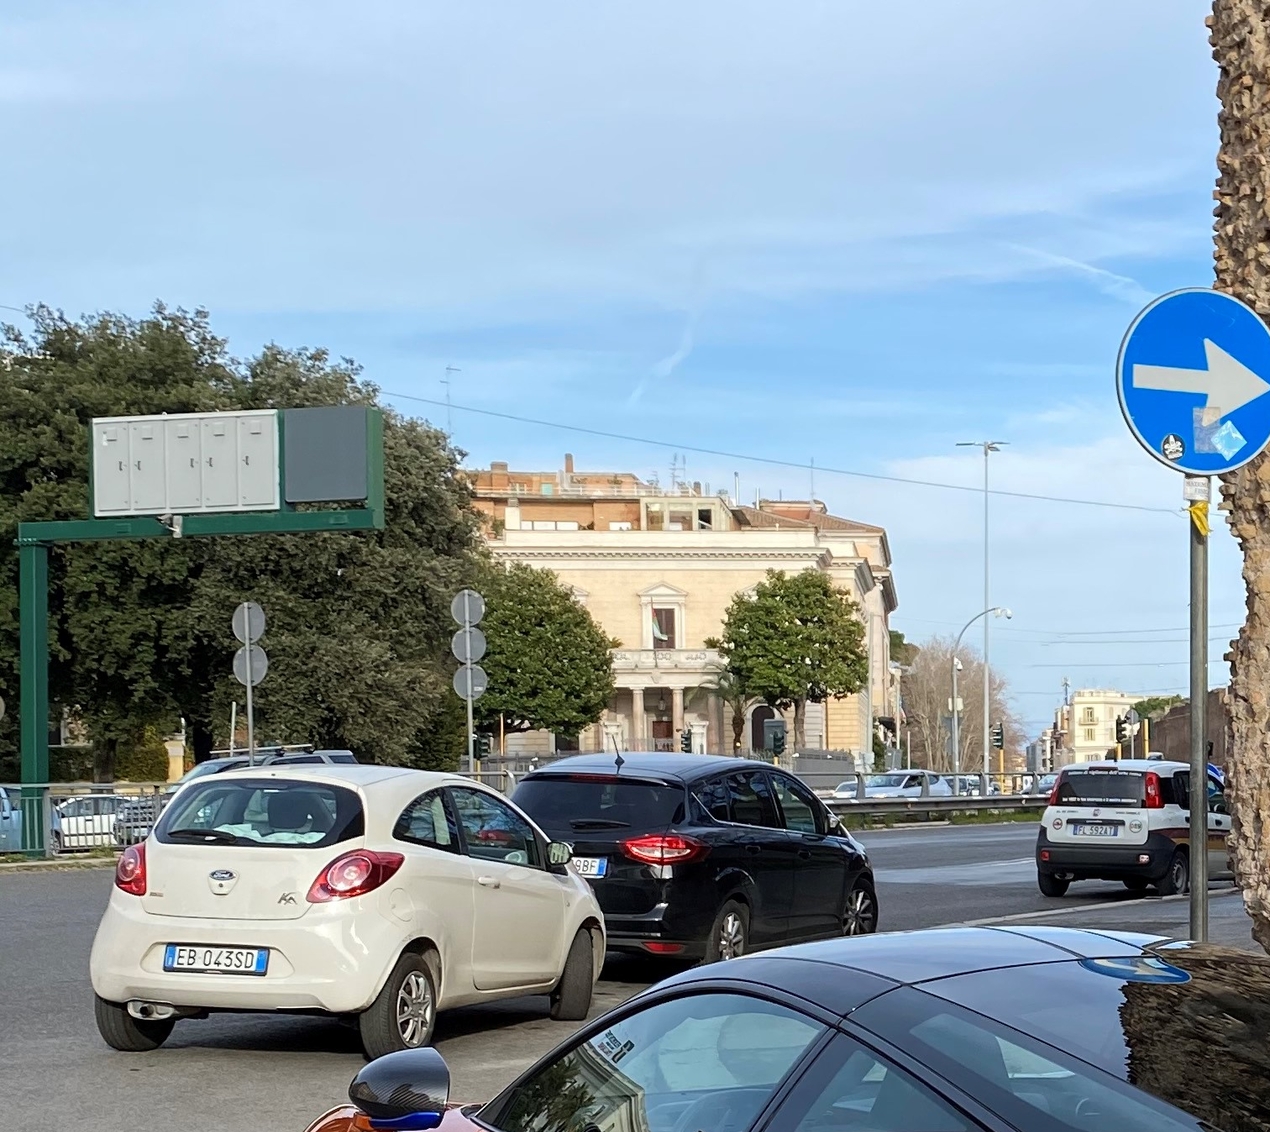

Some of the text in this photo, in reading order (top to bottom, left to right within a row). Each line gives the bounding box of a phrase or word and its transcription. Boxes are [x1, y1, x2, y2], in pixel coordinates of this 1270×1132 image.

[1079, 826, 1114, 836] FL 592AT
[176, 948, 255, 969] EB 043SD
